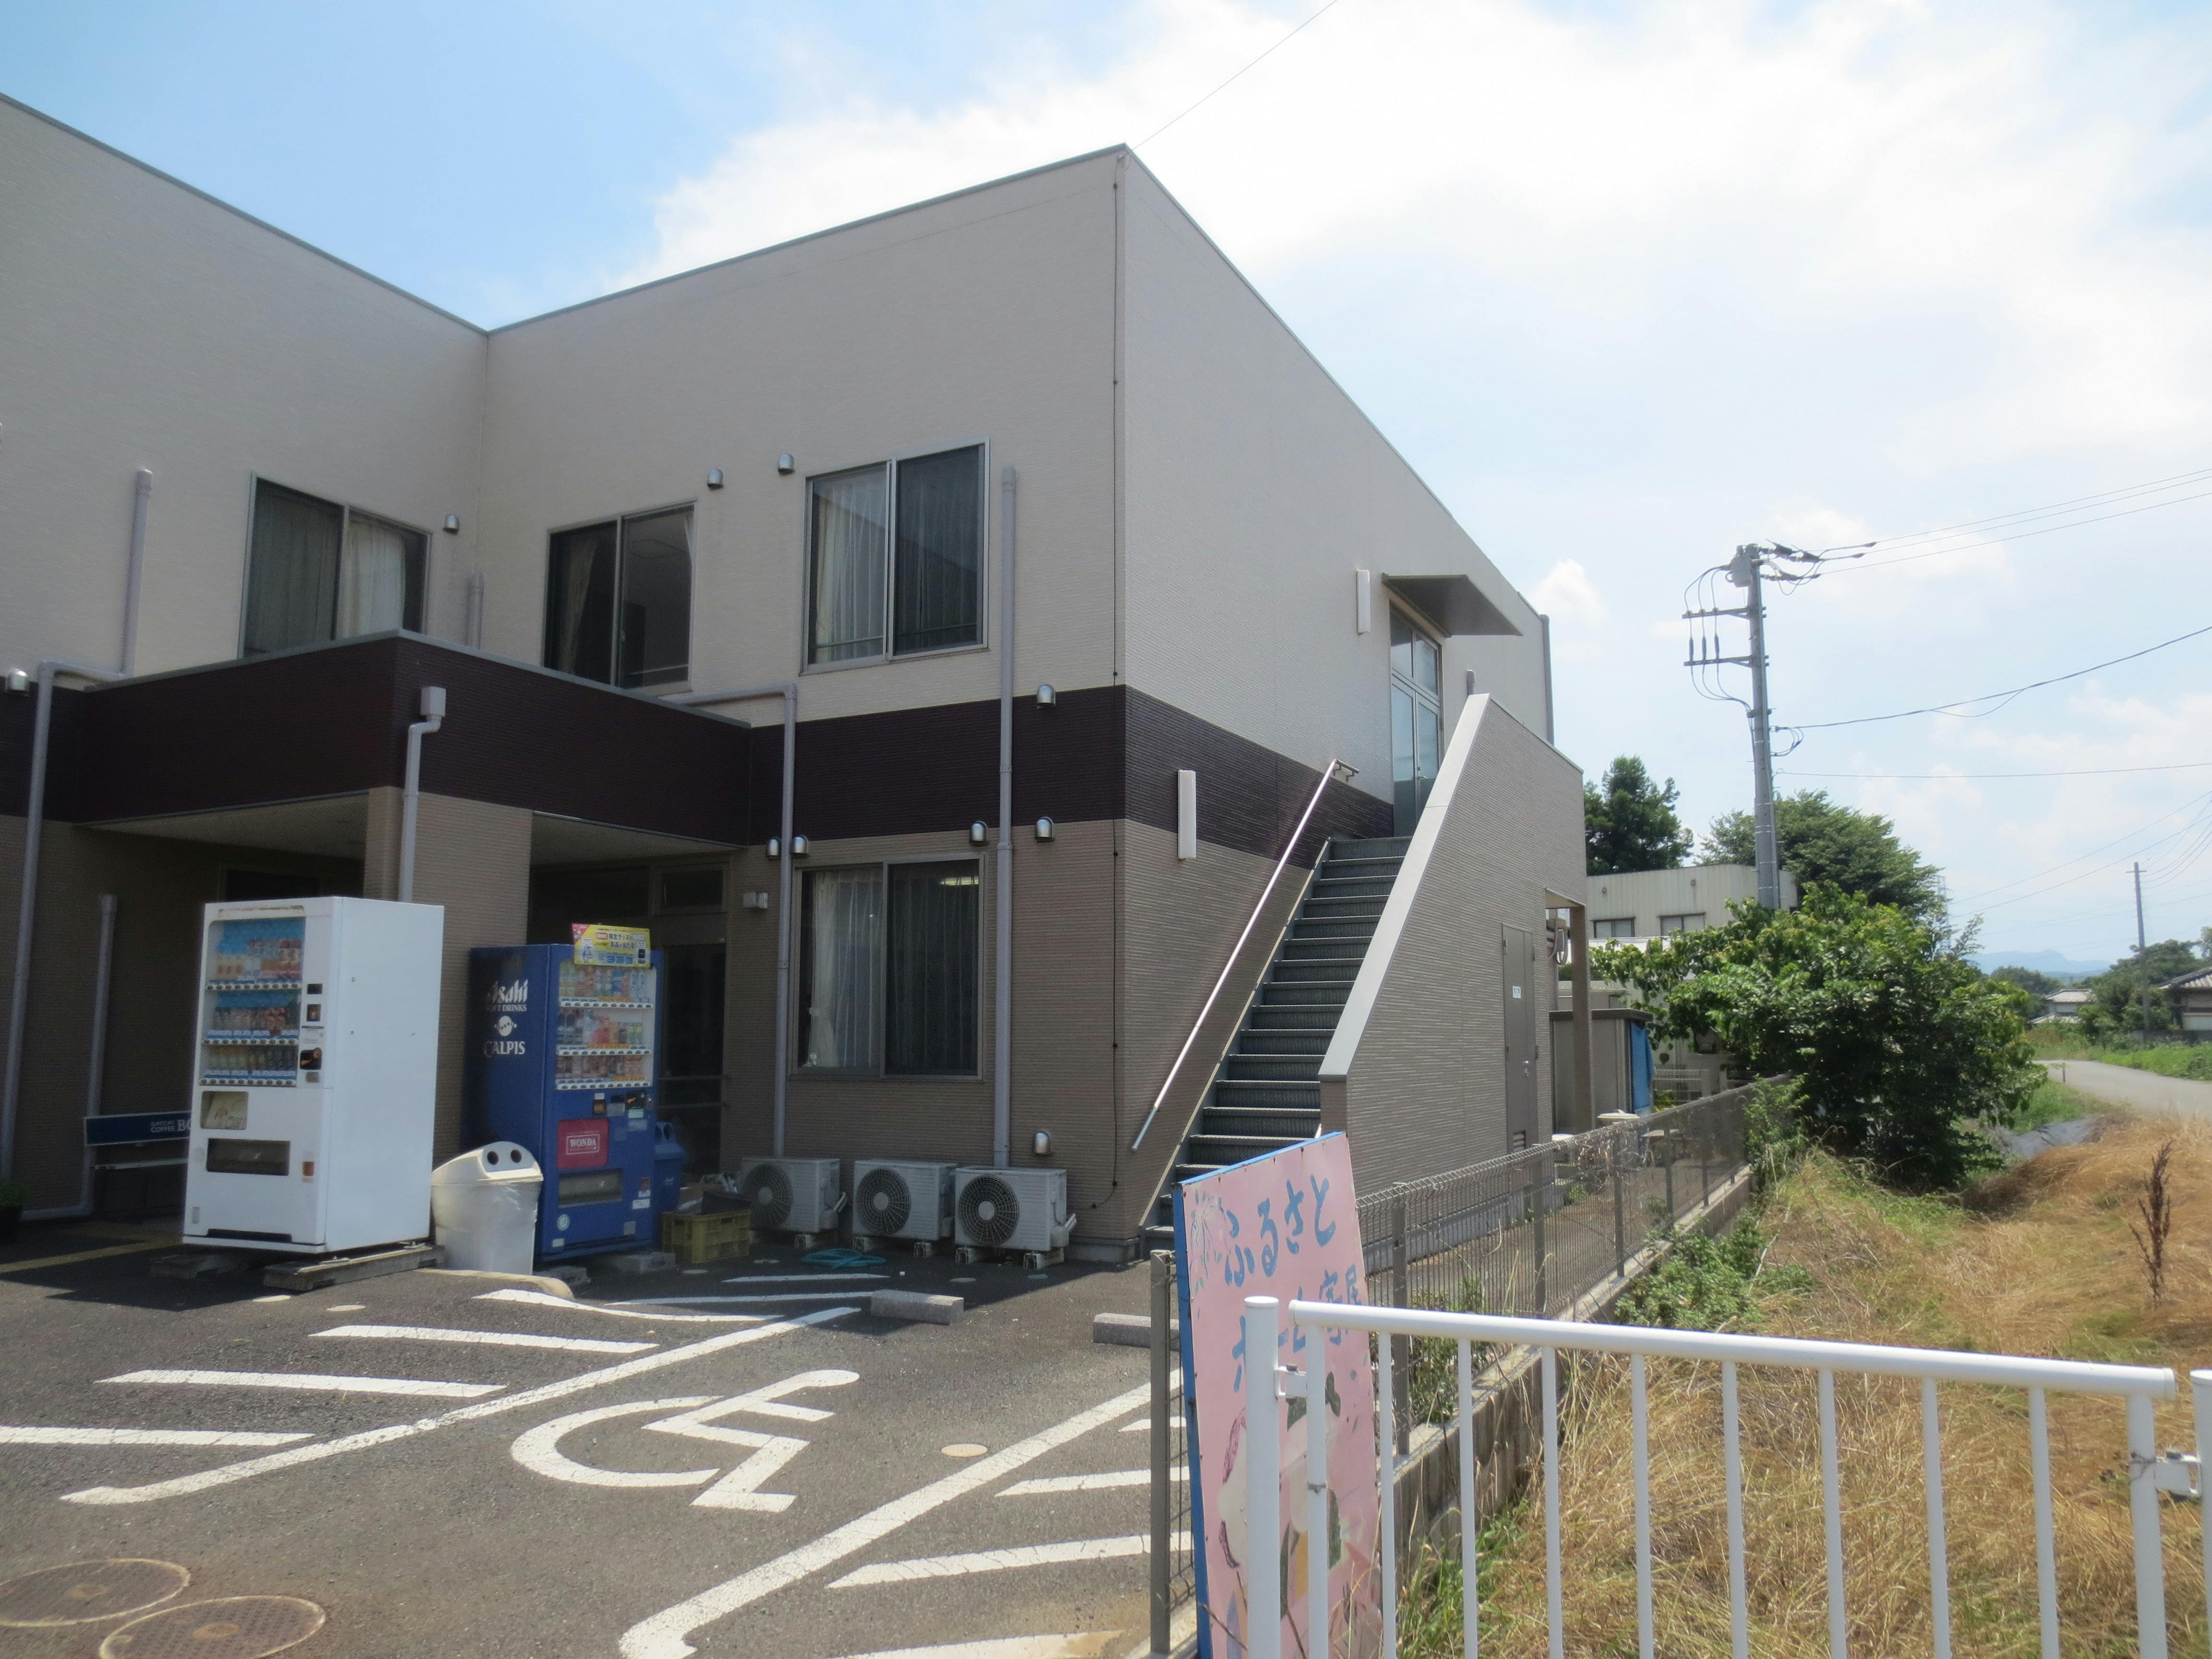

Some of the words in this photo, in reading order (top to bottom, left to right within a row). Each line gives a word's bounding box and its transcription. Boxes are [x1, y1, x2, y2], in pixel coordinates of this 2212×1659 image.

[486, 979, 528, 1003] Asahi
[502, 1004, 527, 1012] DRINKS
[483, 1041, 526, 1058] CALPIS
[570, 1138, 596, 1147] WONDA
[1224, 1174, 1336, 1287] ふるさと
